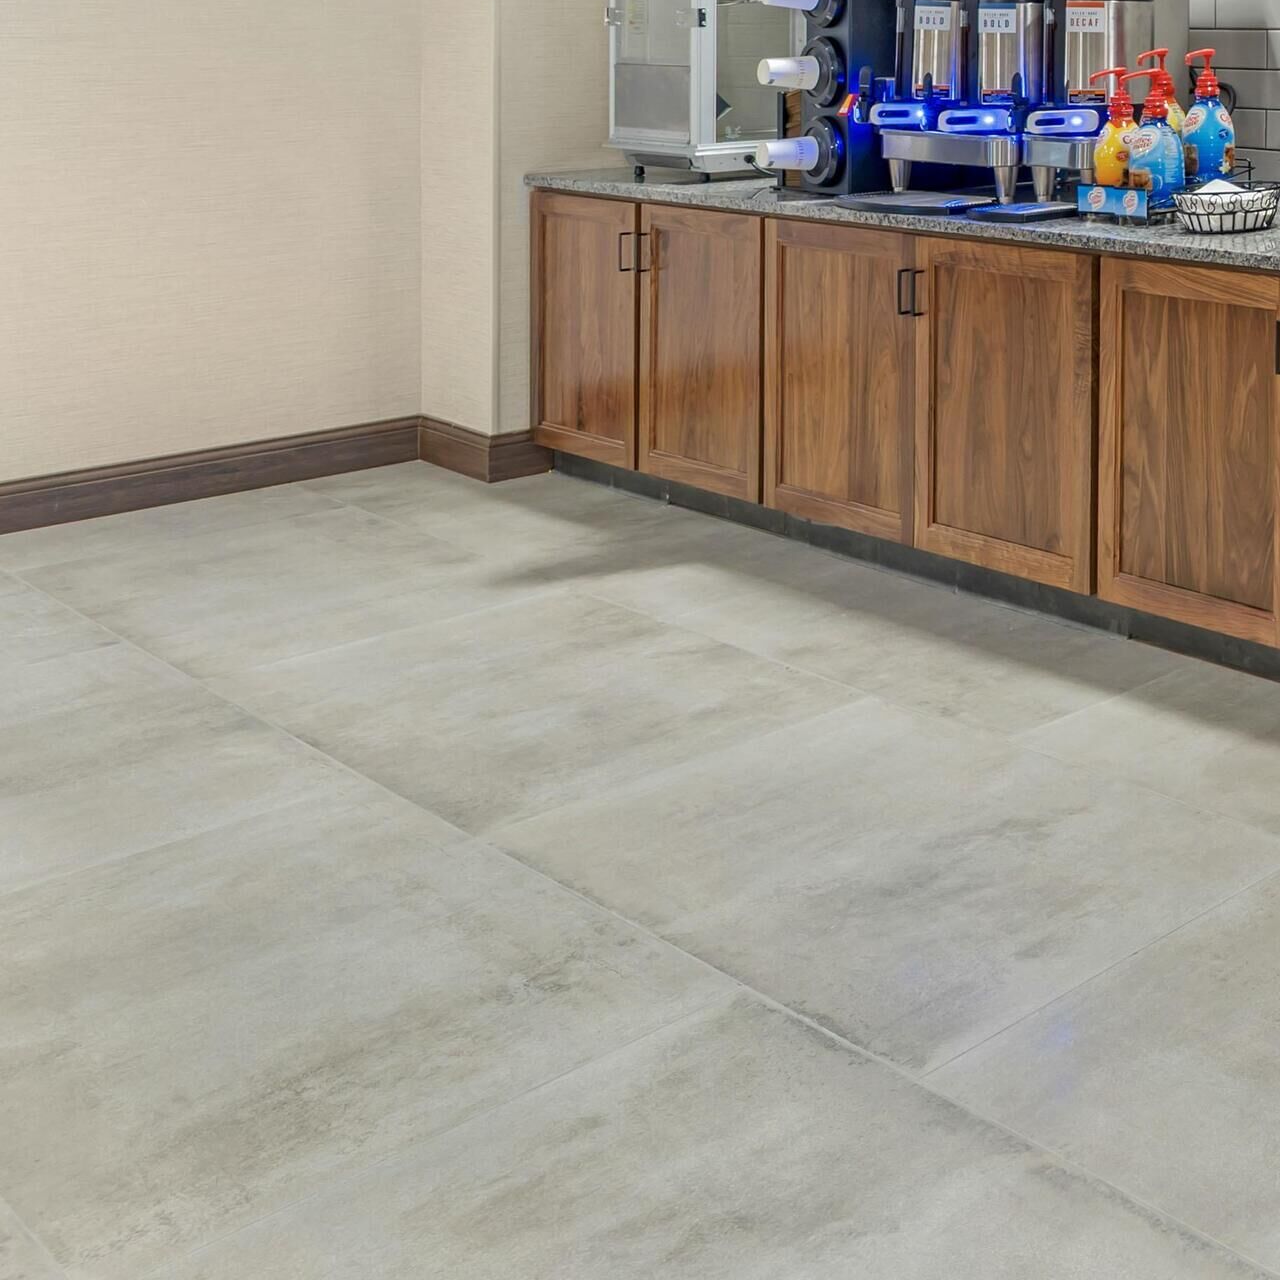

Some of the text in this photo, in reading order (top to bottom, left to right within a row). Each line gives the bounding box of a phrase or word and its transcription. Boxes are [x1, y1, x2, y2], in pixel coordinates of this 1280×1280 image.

[919, 16, 945, 25] BOLD
[983, 19, 1010, 28] BOLD
[1070, 18, 1099, 27] DECAF
